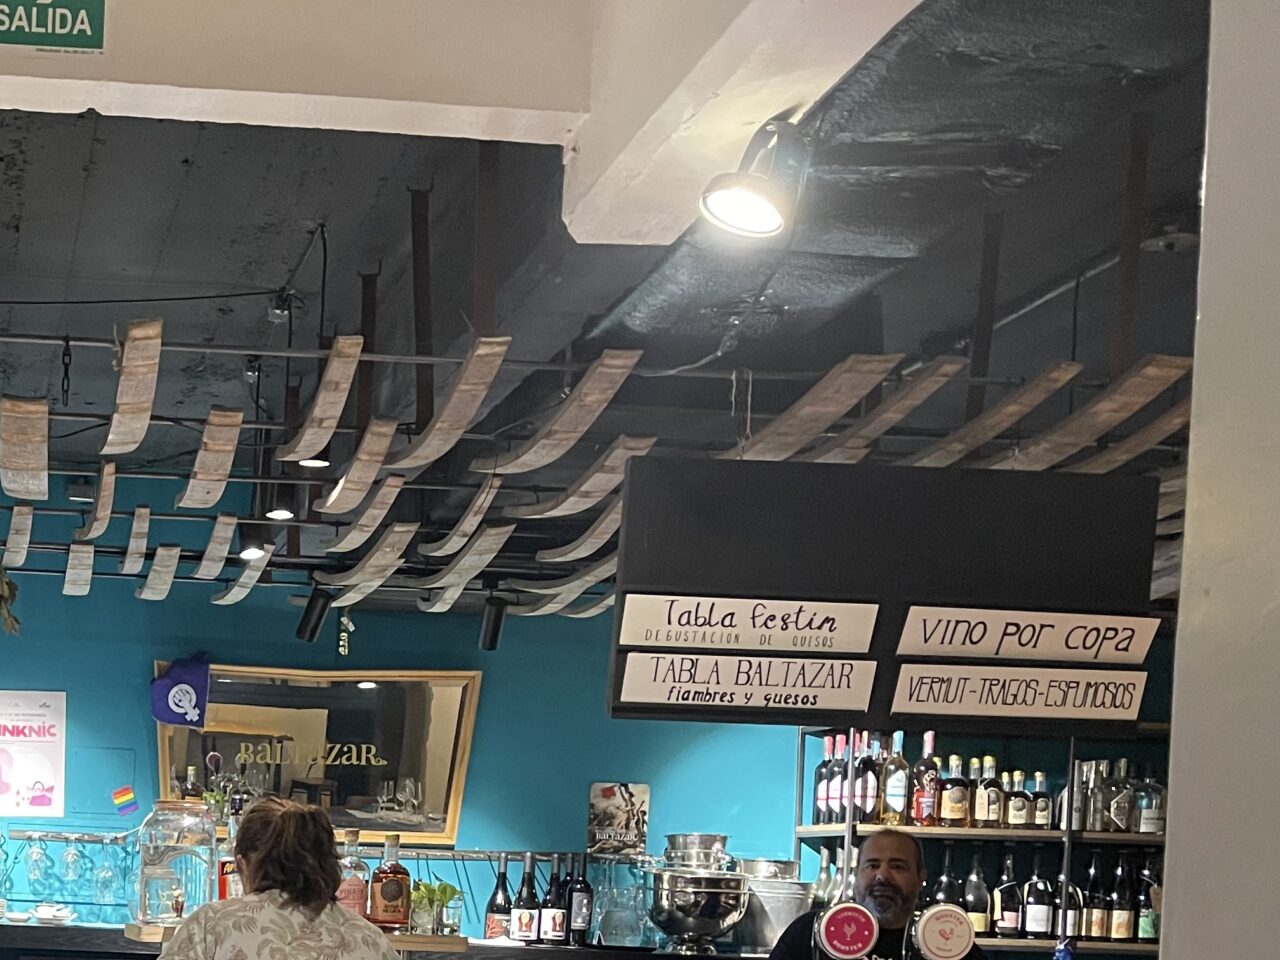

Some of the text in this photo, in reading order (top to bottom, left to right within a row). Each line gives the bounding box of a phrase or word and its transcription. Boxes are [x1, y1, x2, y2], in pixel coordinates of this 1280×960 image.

[665, 599, 737, 628] Tabla
[760, 634, 773, 646] DE
[792, 634, 835, 648] QUESOS
[651, 656, 854, 689] TABLA BALTAZAR
[667, 686, 818, 707] fiambres y quesos
